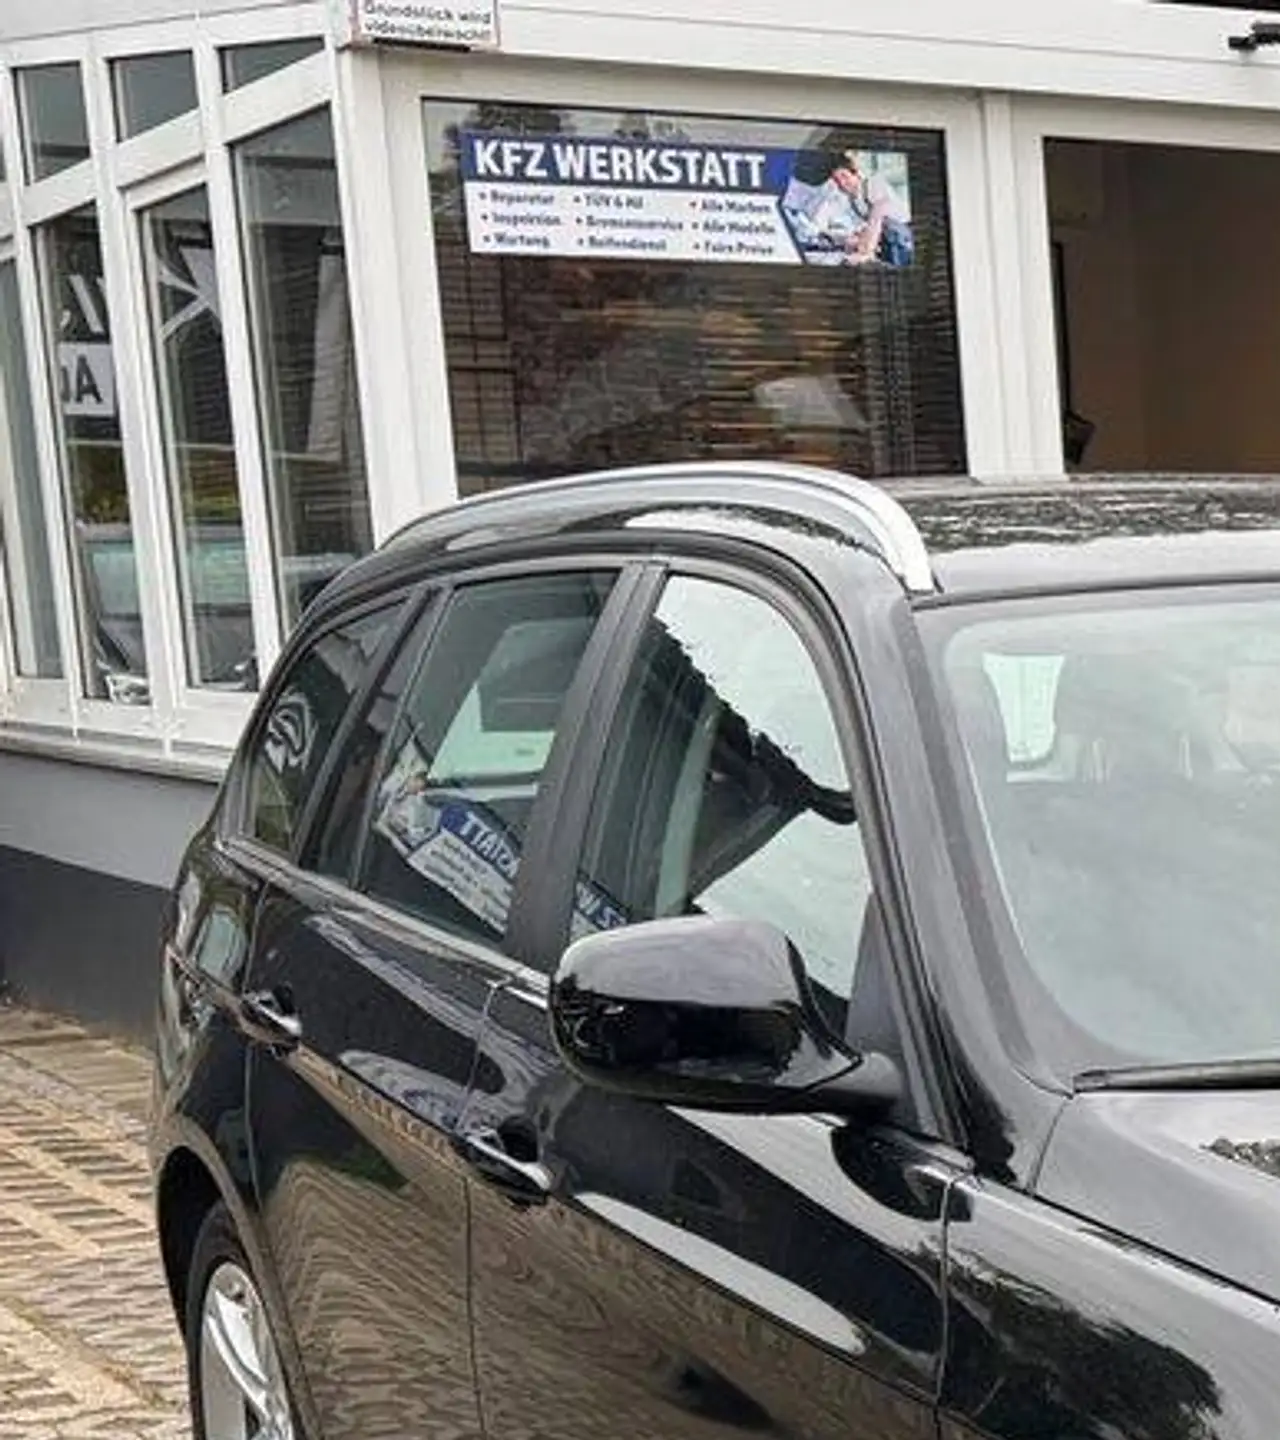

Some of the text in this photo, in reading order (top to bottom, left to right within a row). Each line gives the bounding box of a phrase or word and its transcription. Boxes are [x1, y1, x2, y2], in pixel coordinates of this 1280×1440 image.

[365, 3, 491, 24] Grundstück wird
[473, 138, 766, 187] KFZ WERKSTATT
[490, 190, 555, 208] Reparatur
[492, 212, 562, 228] Inspektion
